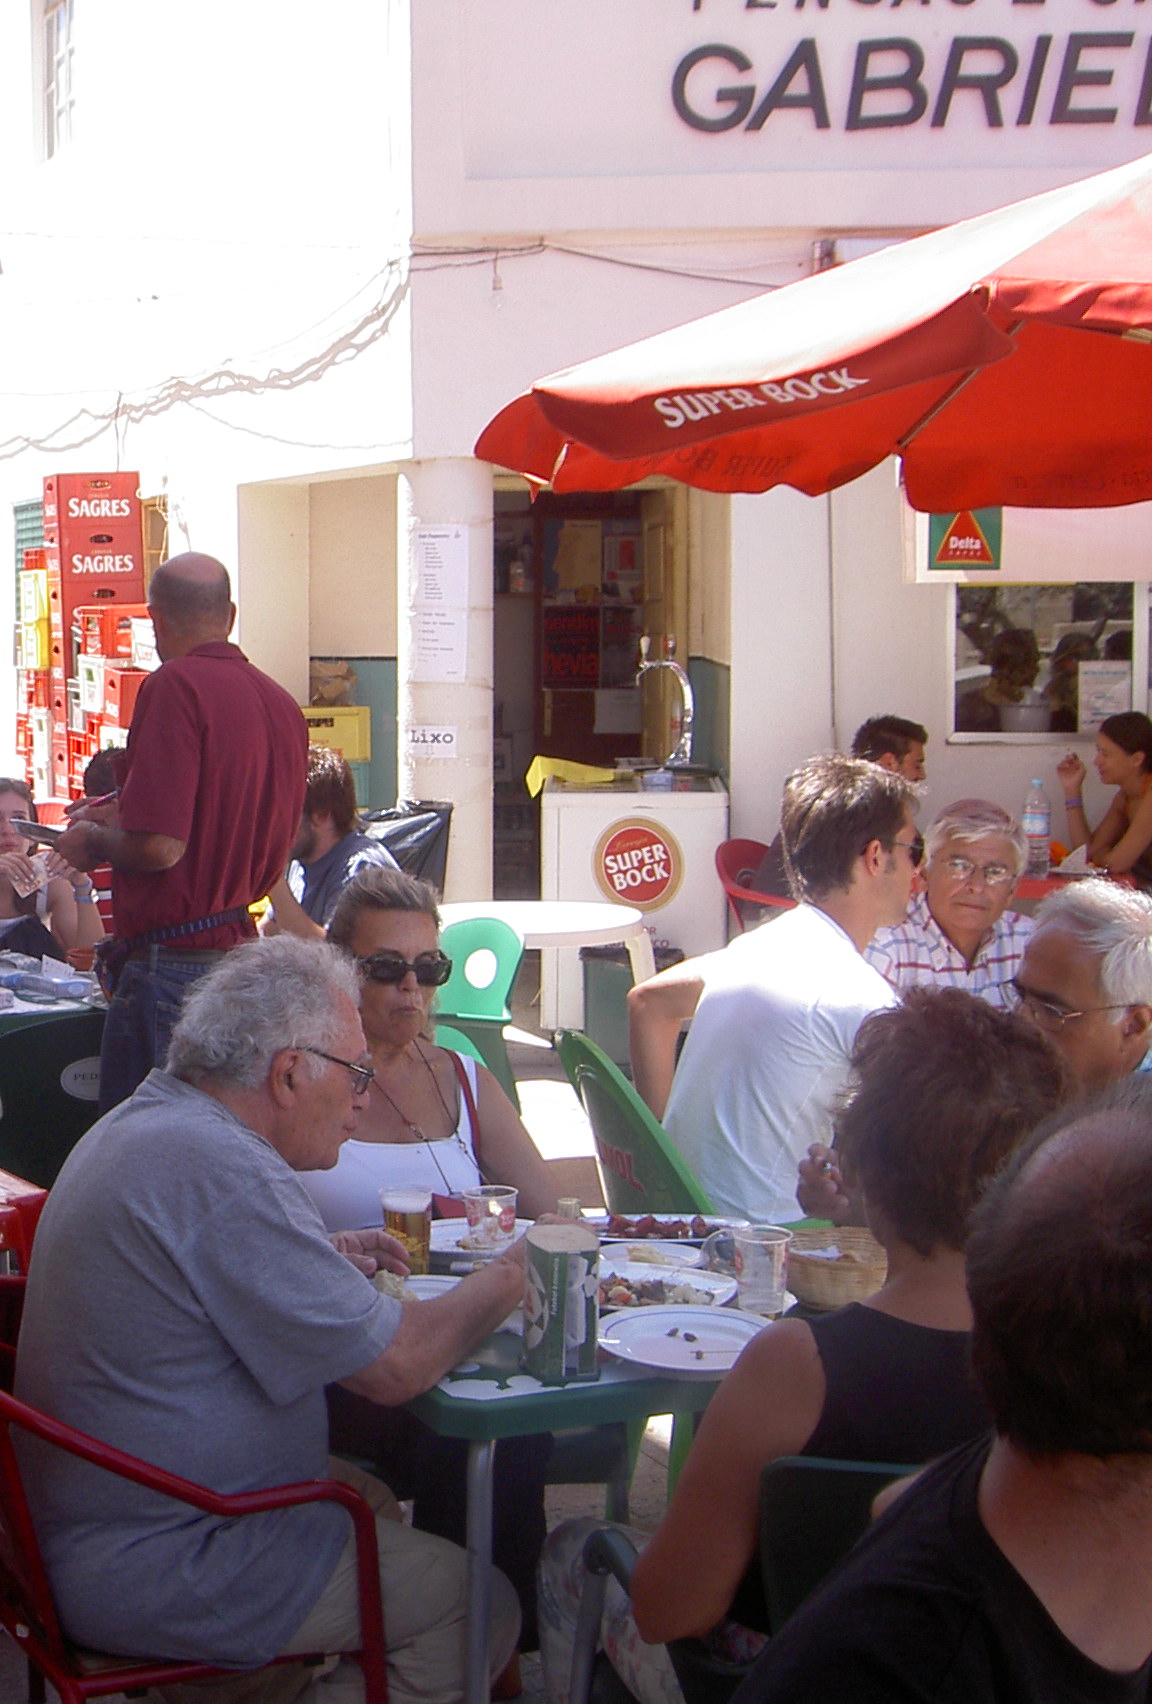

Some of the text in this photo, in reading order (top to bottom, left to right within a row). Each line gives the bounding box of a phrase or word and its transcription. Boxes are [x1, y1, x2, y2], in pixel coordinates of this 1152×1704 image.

[671, 31, 1152, 133] GABRIE
[654, 367, 870, 428] SUPER BOCK
[68, 497, 131, 518] SAGRES
[949, 535, 982, 549] Delta
[71, 554, 134, 574] SAGRES
[410, 730, 454, 744] Lixo
[605, 843, 668, 874] SUPER
[612, 861, 670, 891] BOCK
